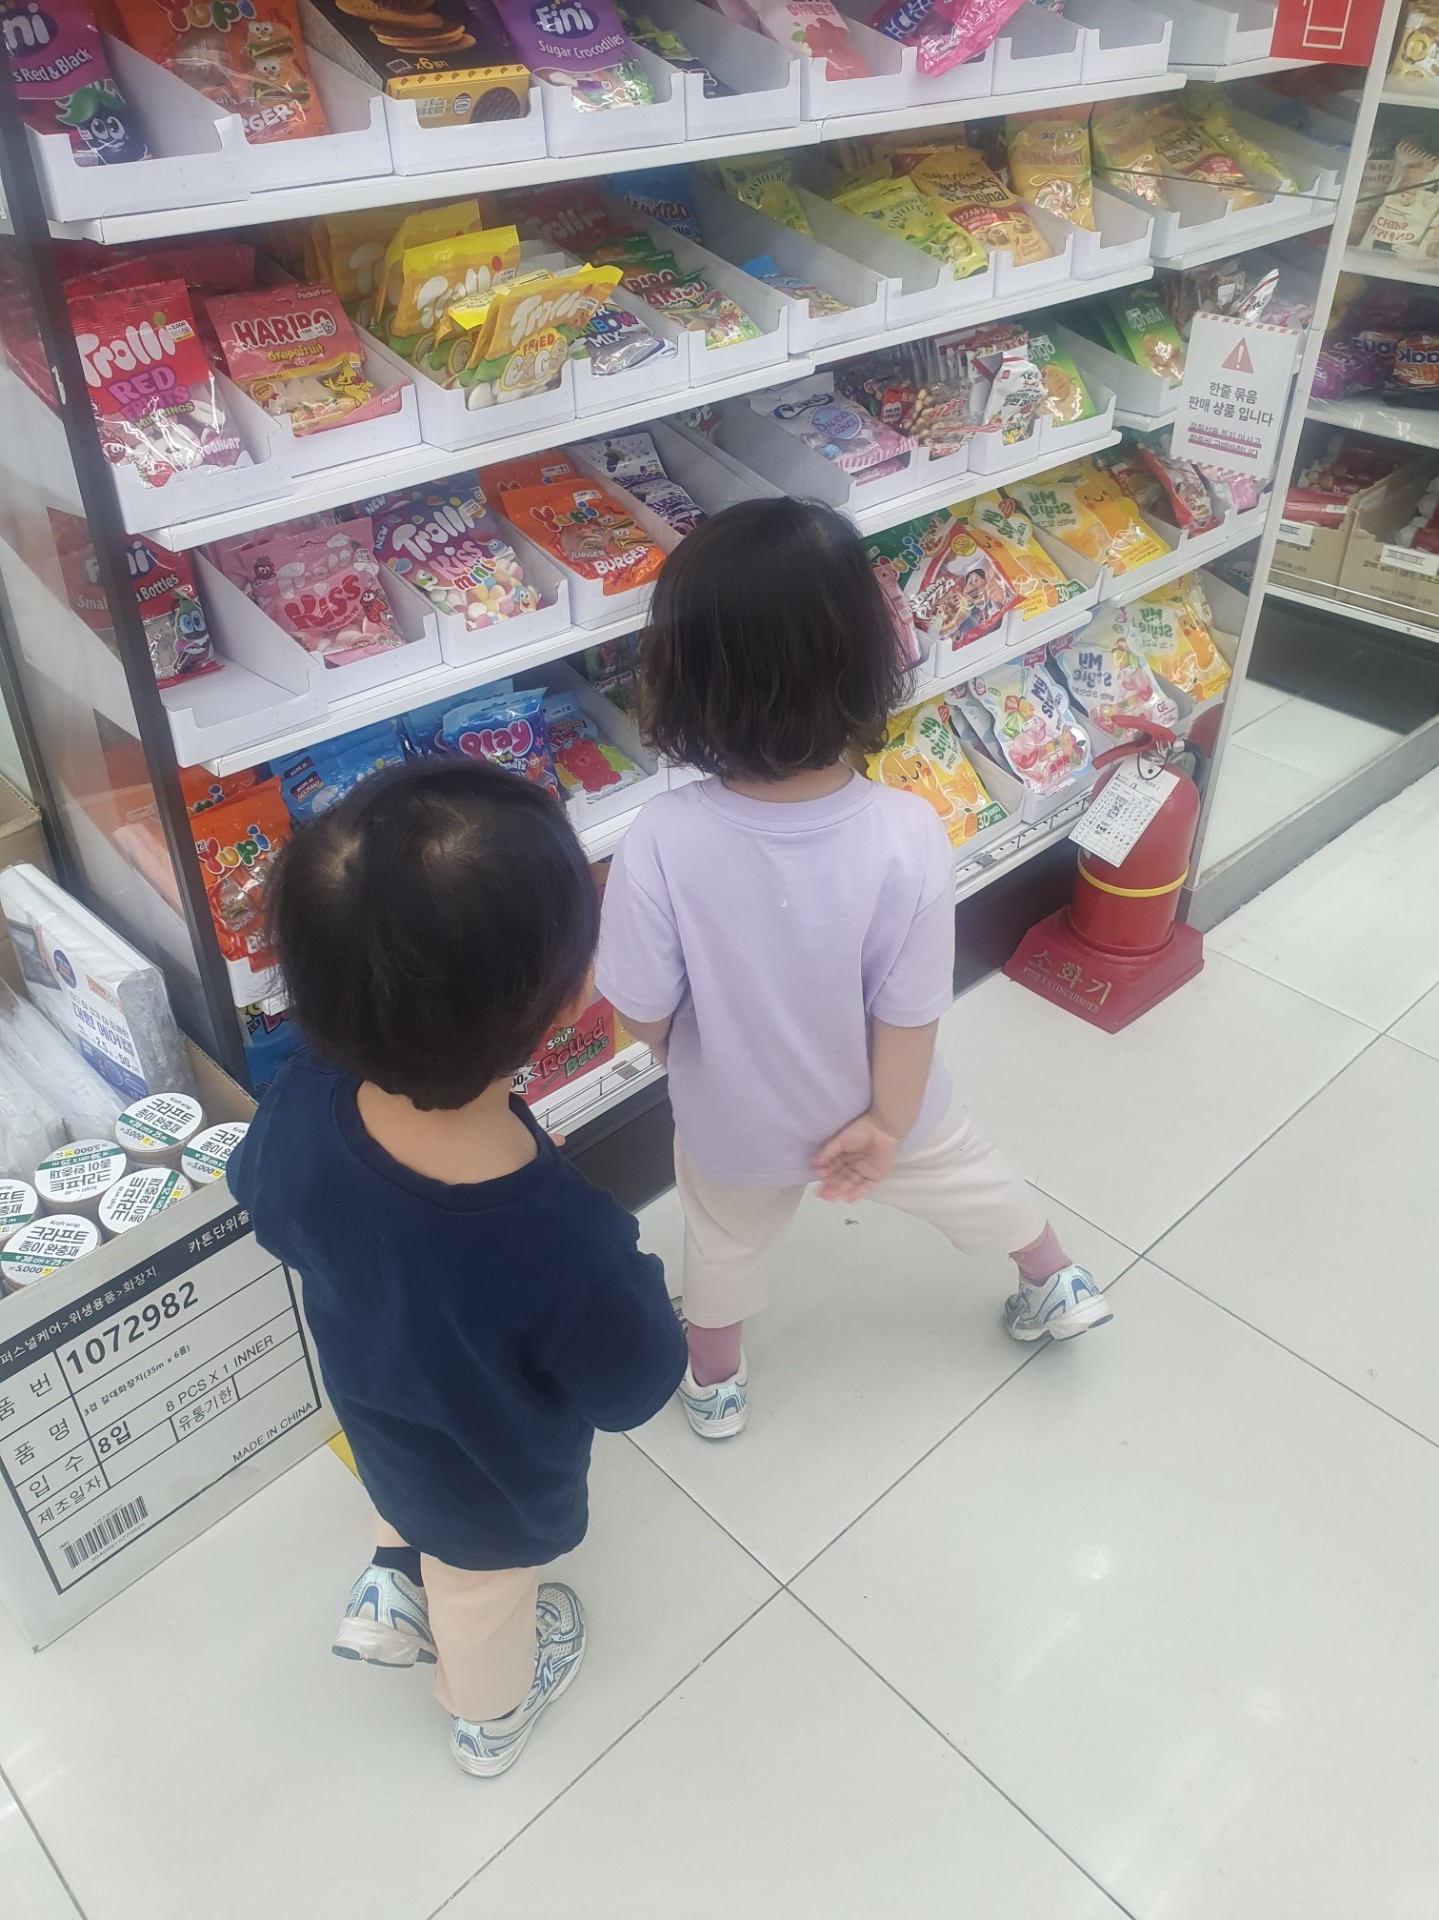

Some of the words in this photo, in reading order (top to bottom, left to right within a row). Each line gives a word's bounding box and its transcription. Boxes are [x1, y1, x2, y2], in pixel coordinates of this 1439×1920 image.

[3, 3, 50, 49] ni
[538, 40, 572, 58] Sugar
[573, 34, 625, 58] Crocodiles
[20, 66, 50, 82] Red
[47, 66, 61, 80] &
[55, 48, 93, 75] Black
[267, 343, 325, 362] Grapefruit
[520, 332, 555, 353] FRIED
[588, 331, 624, 348] MIX
[504, 342, 566, 387] EGGS
[108, 366, 176, 405] RED
[1209, 381, 1232, 399] 한줄
[1234, 387, 1258, 404] 묶음
[1188, 395, 1211, 413] 판매
[1213, 401, 1236, 418] 상품
[1238, 407, 1274, 427] 입니다
[365, 495, 387, 515] NEW
[530, 497, 600, 533] Yupi
[375, 525, 389, 550] NEW
[392, 505, 476, 562] Trolli
[453, 557, 497, 592] minis
[593, 544, 650, 575] BURGER
[140, 574, 180, 601] Bottles
[459, 719, 532, 761] Play
[193, 824, 272, 875] Yupi
[1028, 950, 1112, 1006] 소화기
[540, 1017, 605, 1079] Rolled
[565, 1036, 609, 1079] Belts
[135, 1107, 157, 1121] 종이
[152, 1116, 182, 1134] 완충재
[146, 1098, 196, 1125] 크라프트
[210, 1129, 240, 1147] 크라
[232, 1126, 246, 1135] Kraft
[200, 1141, 223, 1155] 종이
[50, 1165, 85, 1179] 완충재
[50, 1169, 111, 1192] 크라프트
[88, 1158, 111, 1171] 종이
[0, 1190, 26, 1205] 프트
[0, 1204, 22, 1216] 충재
[110, 1177, 148, 1222] 크라프트
[129, 1206, 148, 1223] 종이
[140, 1178, 163, 1204] 완충재
[26, 1226, 90, 1244] 크라프트
[188, 1210, 250, 1254] 카톤단위출
[19, 1240, 45, 1253] 종이
[44, 1243, 81, 1257] 완충재
[15, 1265, 43, 1274] 5,000
[66, 1281, 199, 1375] 1072982
[29, 1373, 53, 1399] 번
[166, 1400, 175, 1412] 8
[178, 1381, 207, 1406] PCS
[207, 1372, 220, 1385] X
[222, 1364, 230, 1375] 1
[233, 1334, 274, 1369] INNER
[178, 1386, 234, 1433] 유통기한
[14, 1441, 36, 1467] 품
[48, 1418, 71, 1442] 명
[97, 1421, 132, 1454] 8입
[232, 1434, 263, 1463] MADE
[262, 1426, 279, 1441] IN
[279, 1402, 314, 1430] CHINA
[29, 1475, 51, 1498] 입
[64, 1455, 85, 1473] 수
[36, 1476, 102, 1526] 제조일자
